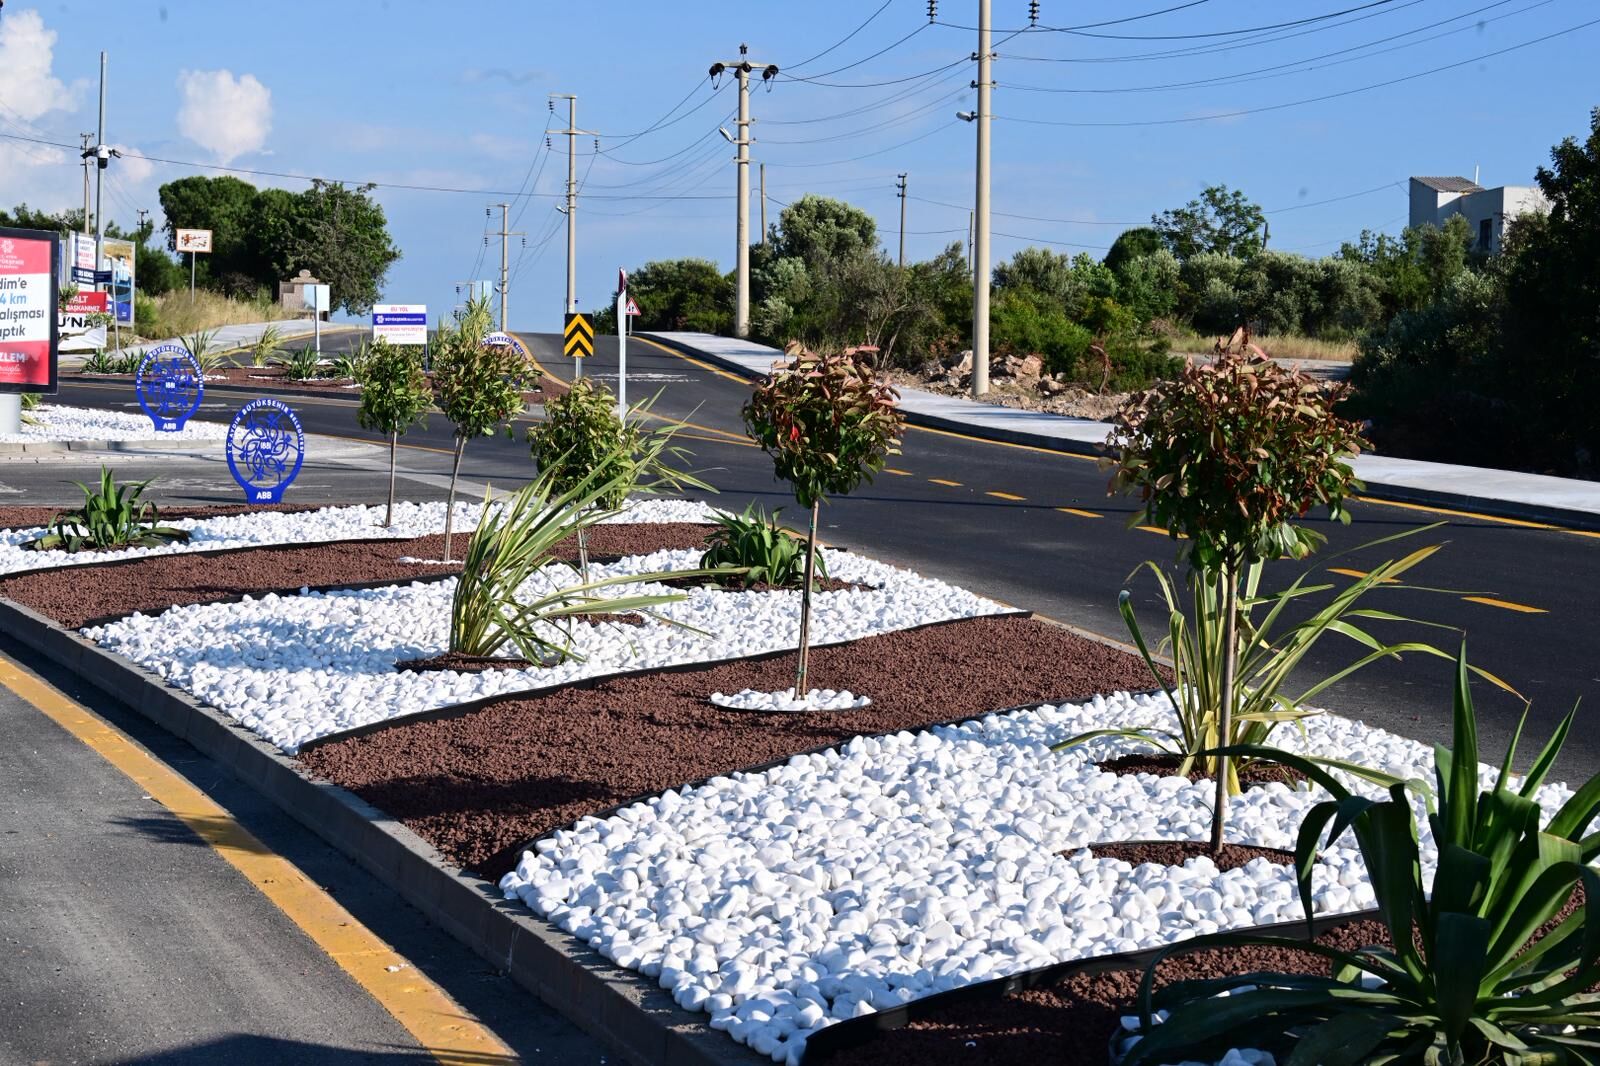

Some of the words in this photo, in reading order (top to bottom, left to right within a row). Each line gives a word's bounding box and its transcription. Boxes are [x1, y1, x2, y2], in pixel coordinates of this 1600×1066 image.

[10, 293, 27, 304] km
[69, 295, 88, 304] ALT
[0, 308, 45, 323] alışması
[0, 324, 26, 340] ptık
[229, 416, 241, 438] AYDIN
[241, 399, 289, 416] BÜYÜKŞEHİR
[162, 422, 177, 430] ABB
[256, 491, 272, 500] ABB
